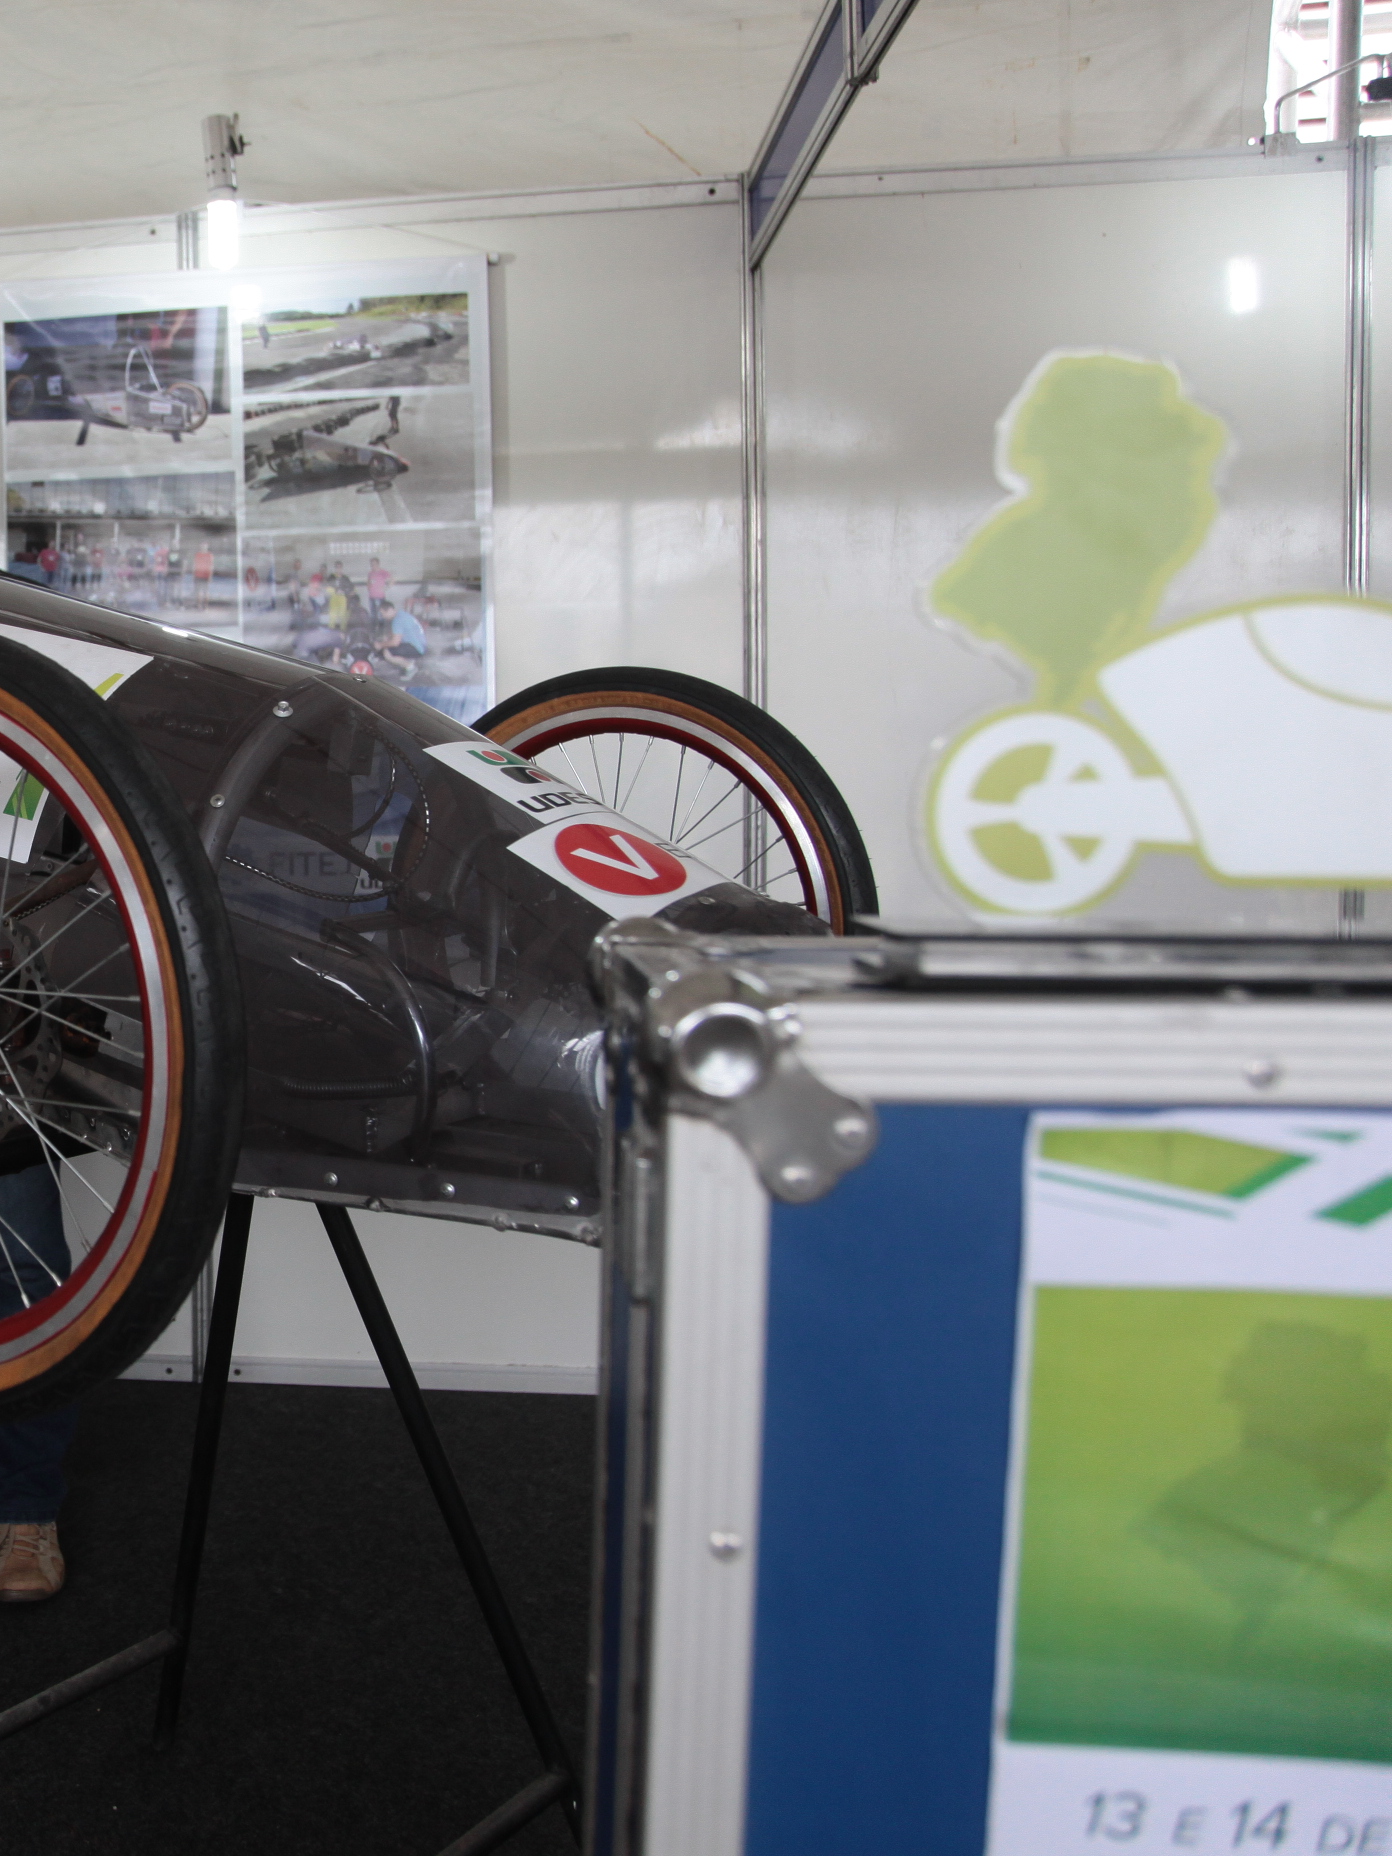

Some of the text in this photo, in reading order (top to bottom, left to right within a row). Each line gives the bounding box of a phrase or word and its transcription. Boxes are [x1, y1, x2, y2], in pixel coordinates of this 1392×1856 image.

[570, 834, 660, 880] V
[1085, 1790, 1392, 1856] 13 E 14 DE
